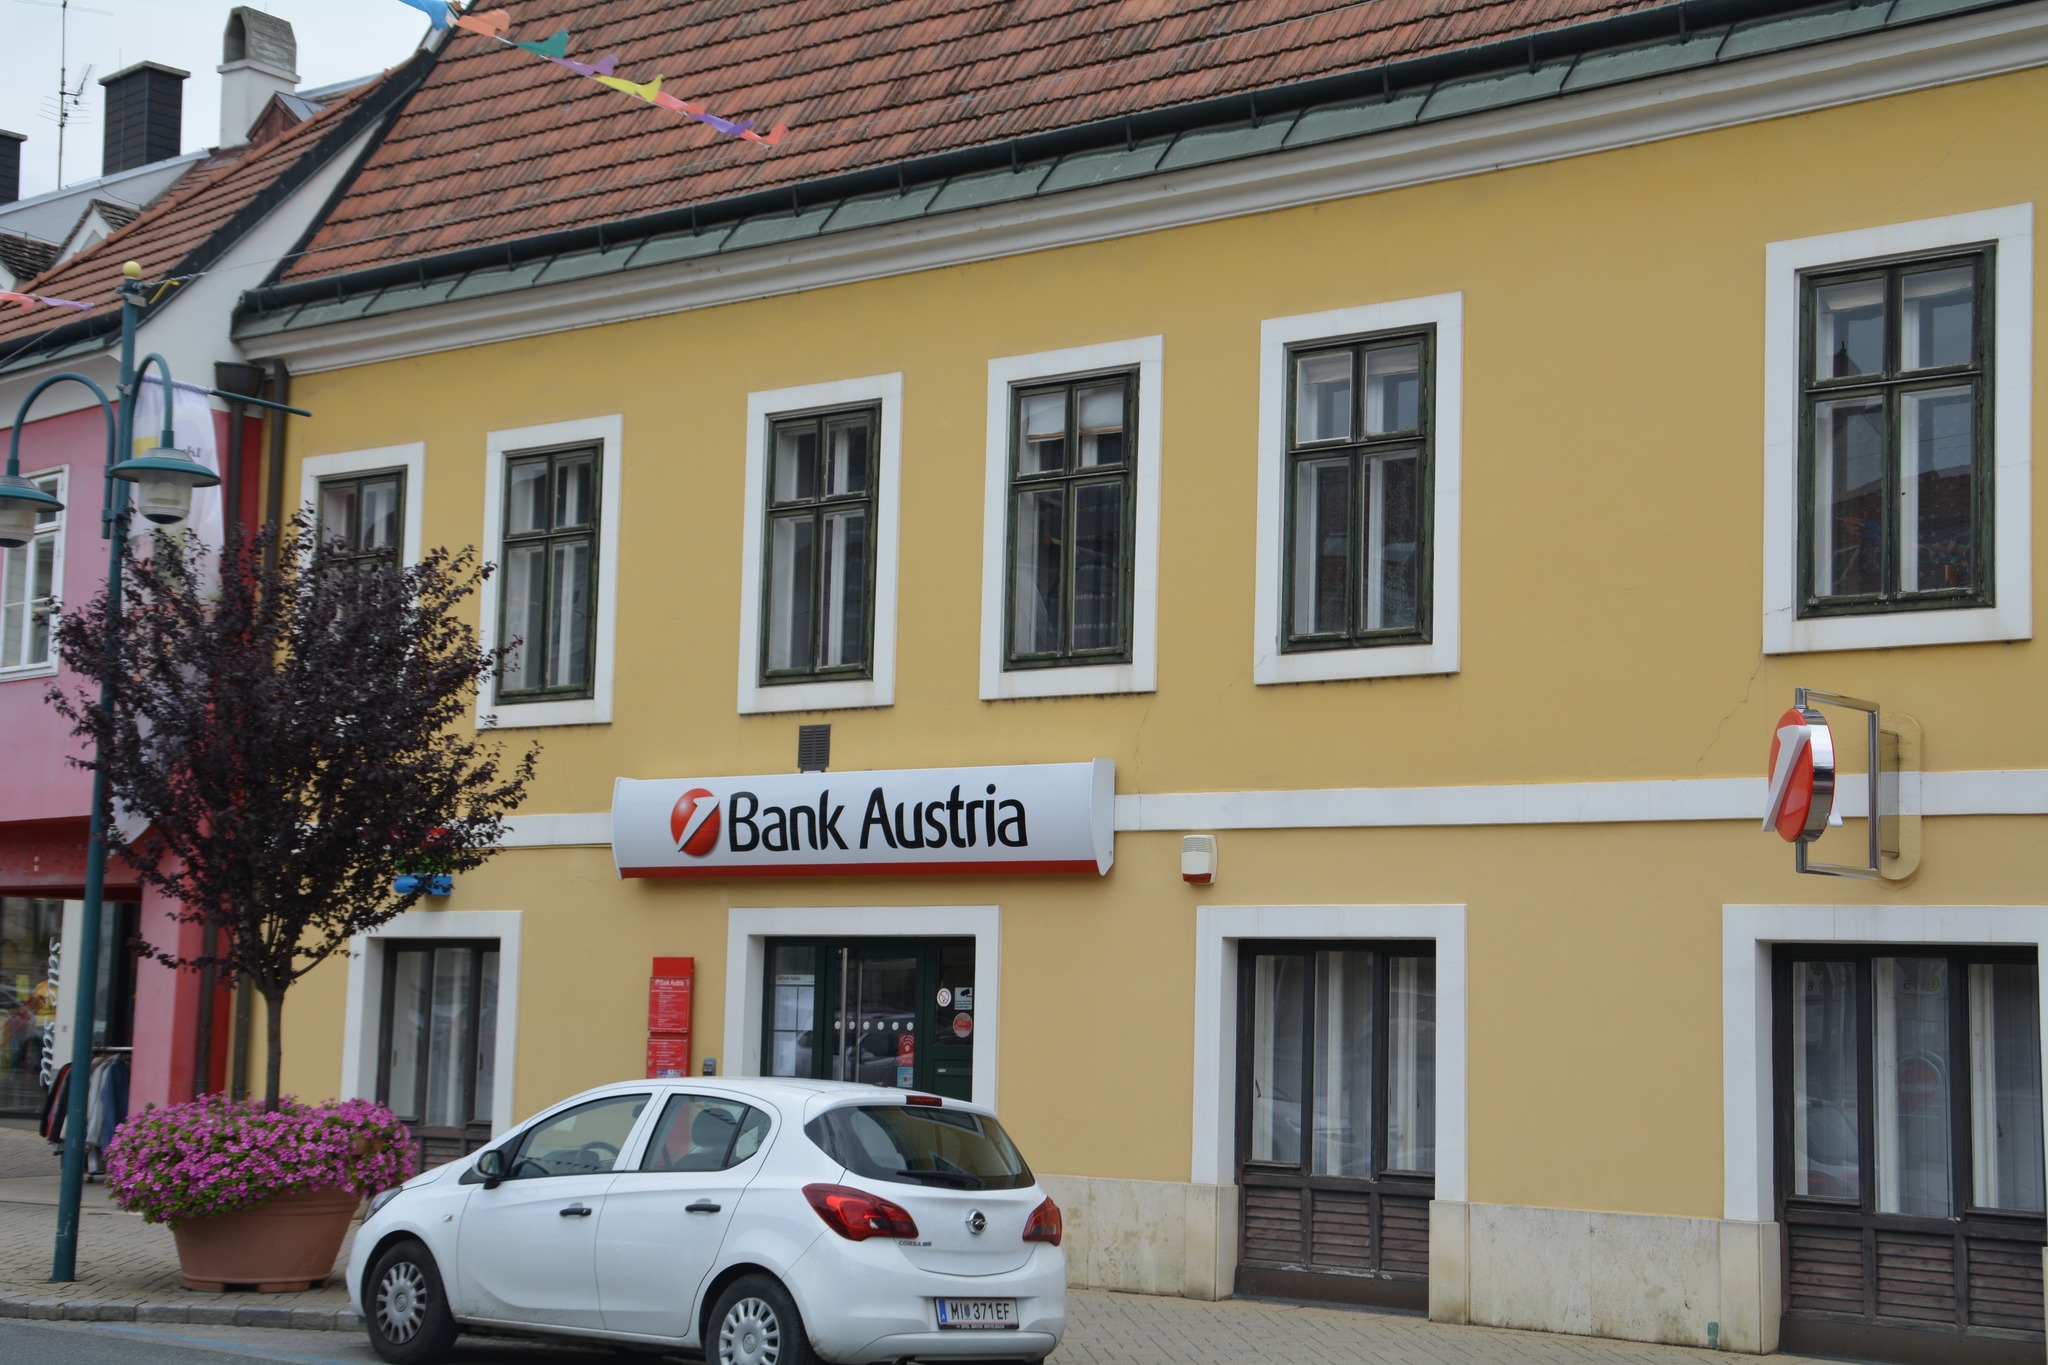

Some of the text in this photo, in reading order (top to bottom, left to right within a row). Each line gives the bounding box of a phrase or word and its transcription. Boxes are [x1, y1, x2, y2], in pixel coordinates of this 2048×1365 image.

[728, 783, 1028, 852] Bank Austria
[950, 1302, 964, 1320] MI
